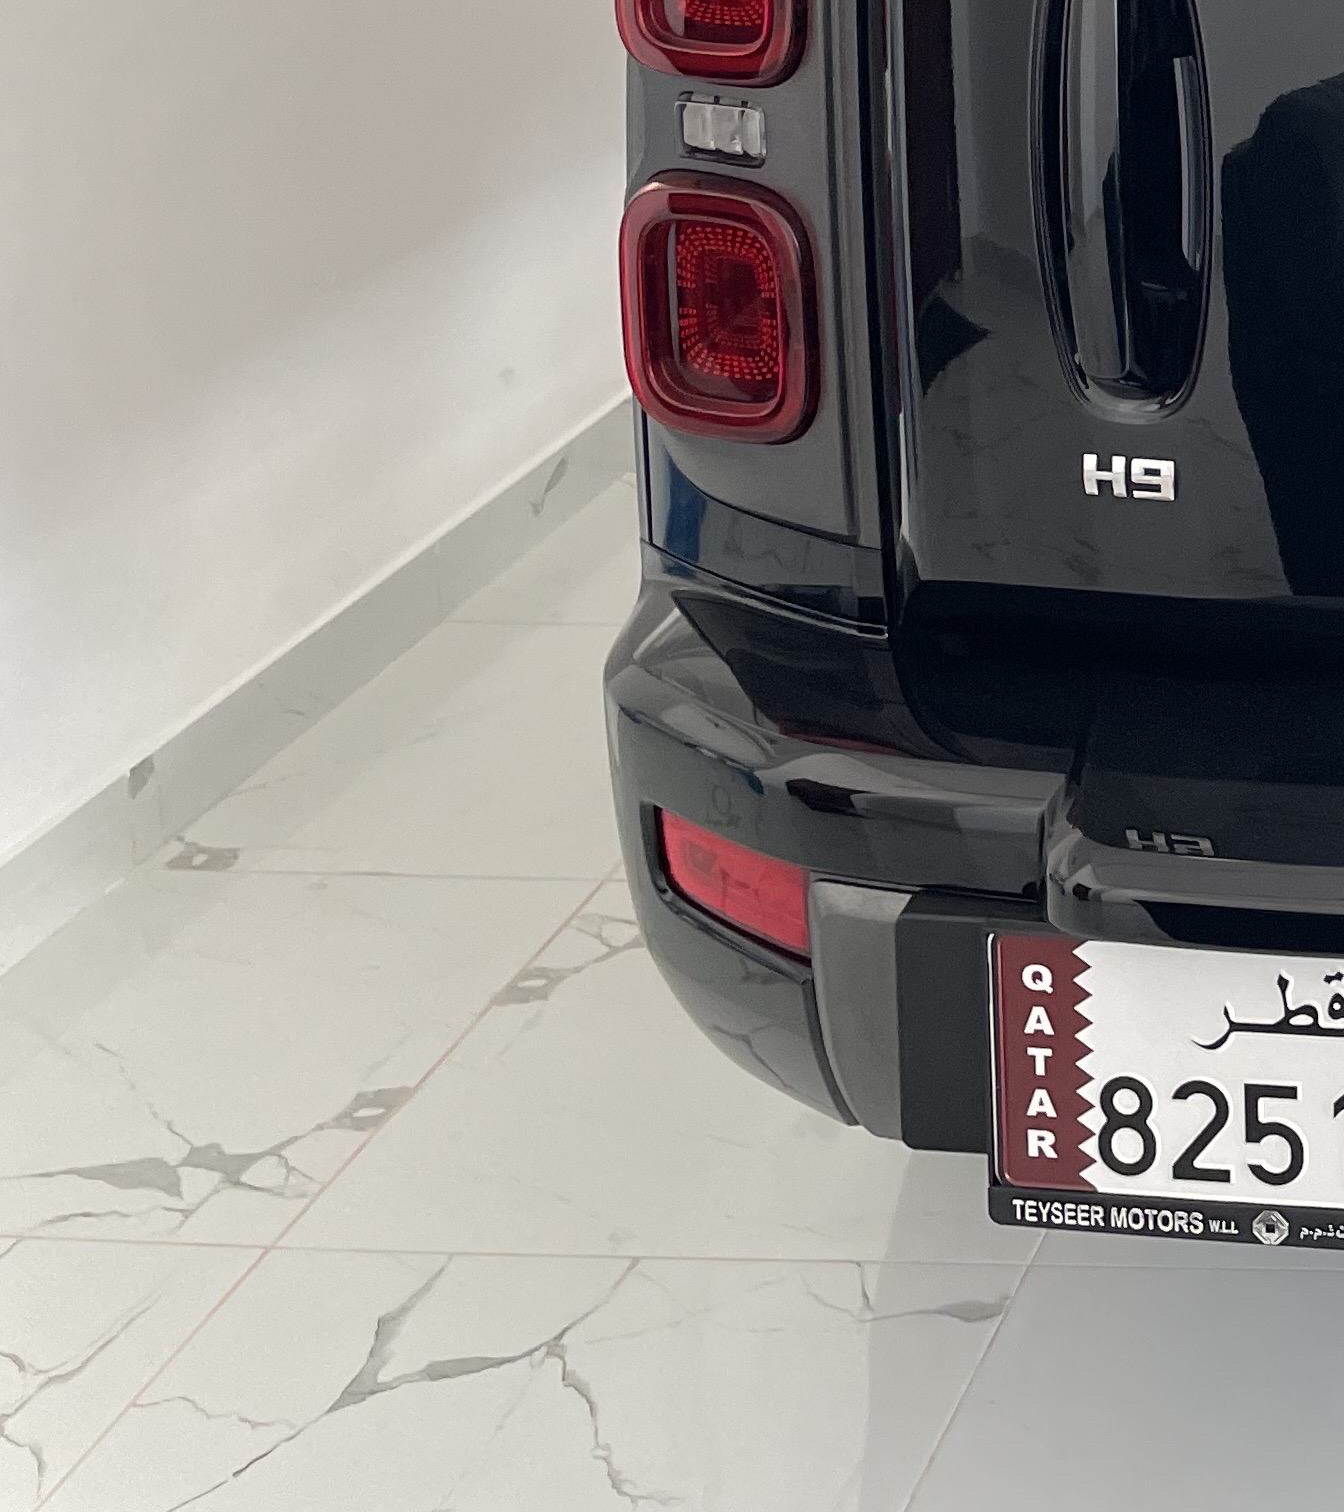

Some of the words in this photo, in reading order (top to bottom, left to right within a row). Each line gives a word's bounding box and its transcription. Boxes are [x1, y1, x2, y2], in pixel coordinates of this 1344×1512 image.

[1083, 453, 1176, 501] H9
[1021, 963, 1058, 1160] QATAR
[1012, 1199, 1105, 1227] TEYSEER
[1111, 1207, 1205, 1234] MOTORS
